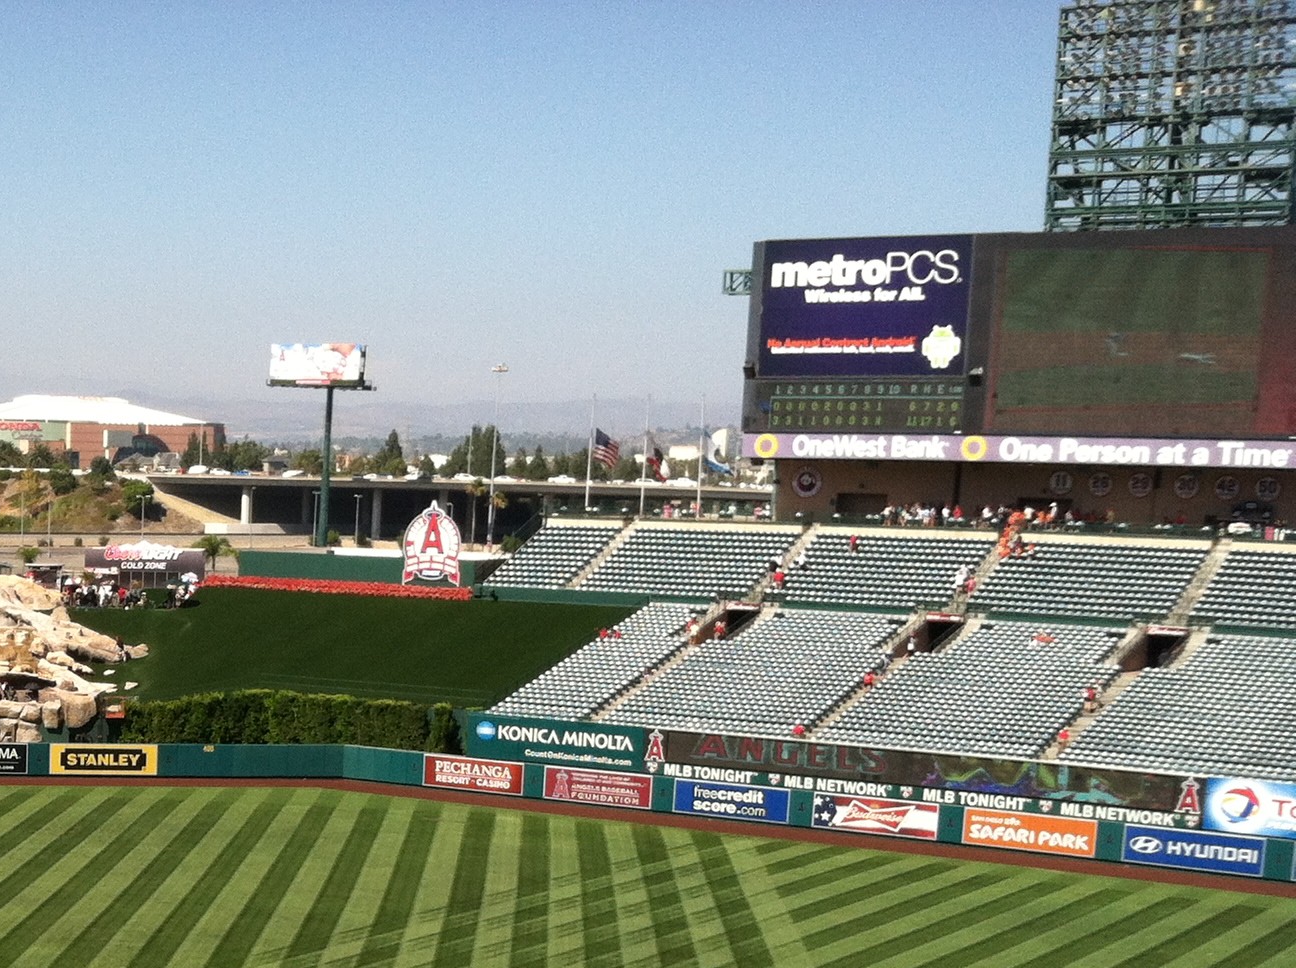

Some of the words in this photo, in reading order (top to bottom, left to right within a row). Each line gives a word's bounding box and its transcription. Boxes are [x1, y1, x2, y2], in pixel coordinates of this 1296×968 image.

[771, 250, 959, 287] metroPCS
[805, 289, 871, 303] Wireless
[874, 288, 898, 301] for
[792, 434, 886, 458] OneWest
[891, 436, 946, 458] Bank
[999, 437, 1053, 462] One
[1059, 438, 1150, 464] Person
[1156, 442, 1185, 465] at
[1191, 446, 1209, 466] a
[1217, 441, 1289, 467] Time
[420, 499, 445, 555] A
[142, 547, 183, 560] LIGHT
[120, 562, 144, 570] COLD
[144, 562, 167, 570] ZONE
[498, 725, 560, 745] KONICA
[562, 730, 634, 752] MINOLTA
[67, 753, 140, 766] STANLEY
[691, 734, 888, 774] ANGELS
[435, 760, 512, 779] PECHANGA
[435, 774, 470, 786] RESORT
[476, 778, 511, 790] CASINO
[570, 792, 639, 805] FOUNDATION
[664, 763, 692, 777] MLB
[694, 765, 753, 783] TONIGHT
[784, 775, 814, 789] MLB
[816, 778, 887, 797] NETWORK
[923, 788, 955, 803] MLB
[958, 792, 1025, 811] TONIGHT
[1060, 802, 1093, 817] MLB
[1095, 807, 1174, 827] NETWORK
[694, 785, 764, 804] freecredit
[693, 799, 766, 817] score.com
[844, 806, 905, 823] Budweiser
[969, 824, 1035, 843] SAFARI
[1038, 830, 1089, 850] PARK
[1167, 840, 1258, 863] HYUNDAI
